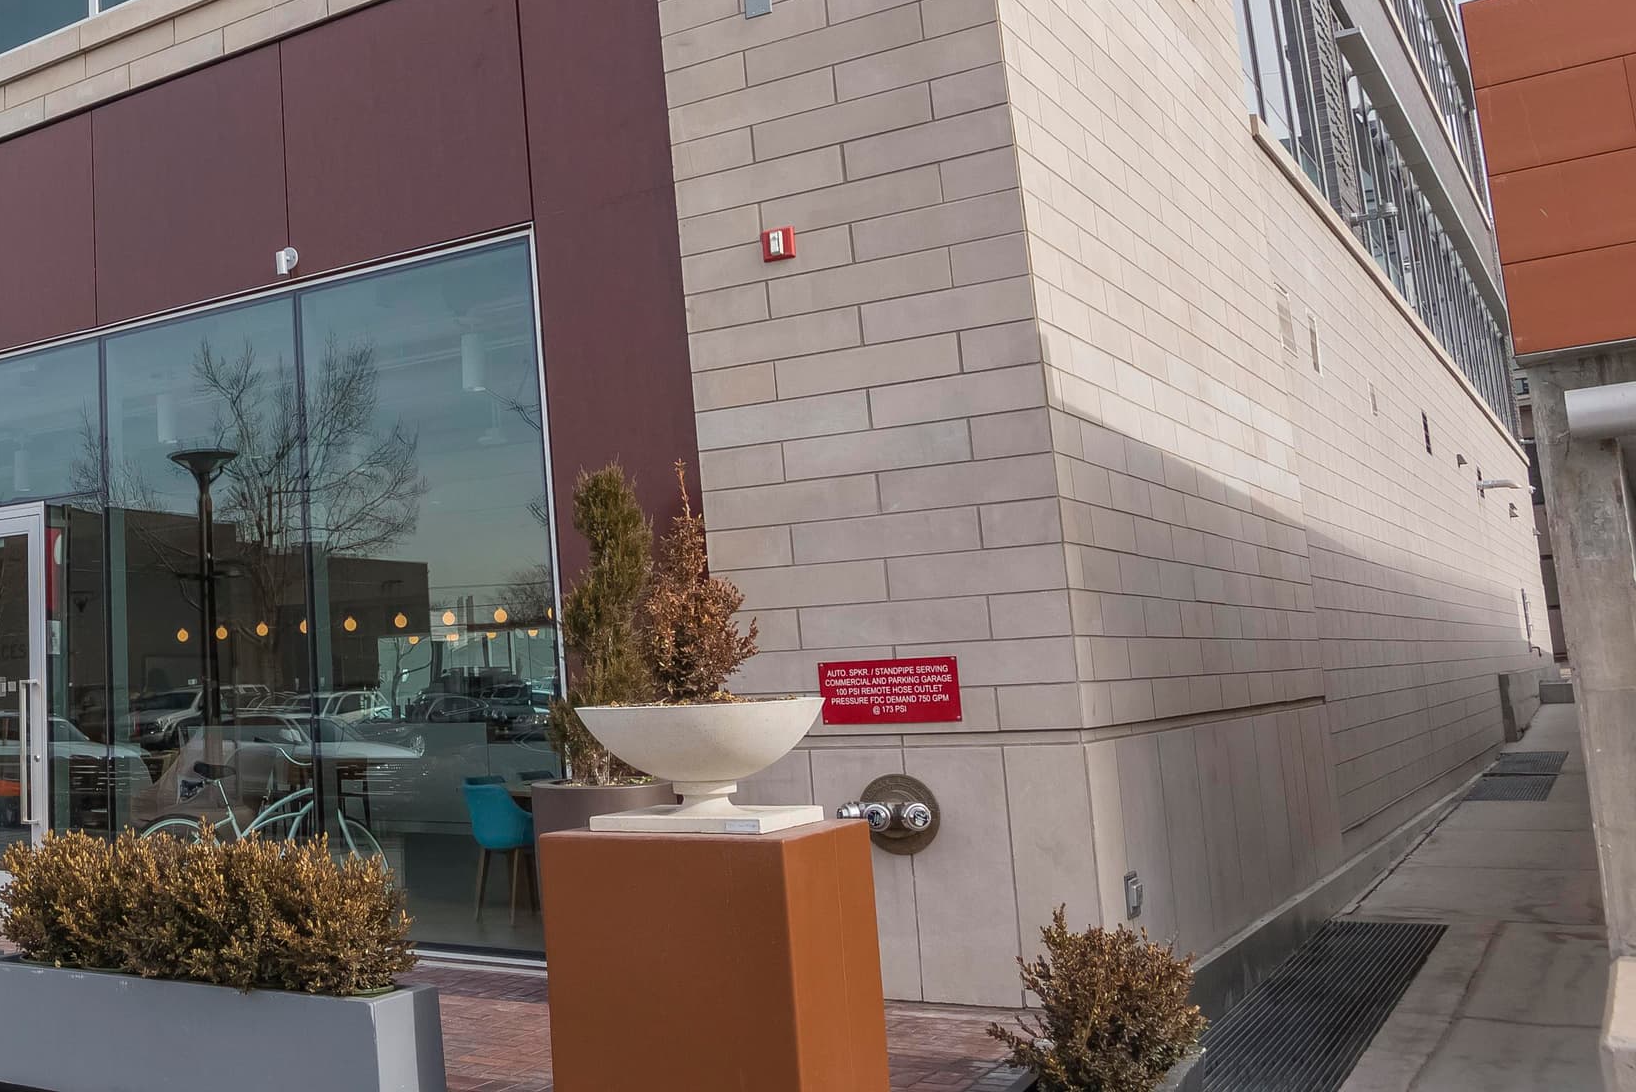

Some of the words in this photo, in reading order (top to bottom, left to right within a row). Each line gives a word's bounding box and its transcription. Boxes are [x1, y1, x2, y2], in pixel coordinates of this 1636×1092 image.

[827, 669, 848, 677] AUTO.
[875, 666, 915, 676] STANDPIPE
[916, 665, 949, 674] SERVING
[825, 677, 871, 687] COMMERCIAL
[872, 677, 886, 685] AND
[888, 675, 920, 684] PARKING
[921, 674, 953, 683] GARAGE
[836, 688, 848, 696] 100
[861, 686, 891, 695] REMOTE
[892, 685, 913, 694] HOSE
[914, 684, 943, 693] OUTLET
[831, 696, 869, 705] PRESSURE
[870, 696, 885, 704] FDC
[887, 695, 917, 704] DEMAND
[918, 694, 931, 702] 750
[932, 693, 949, 702] GPM
[872, 706, 881, 715] @
[895, 705, 907, 713] PSI
